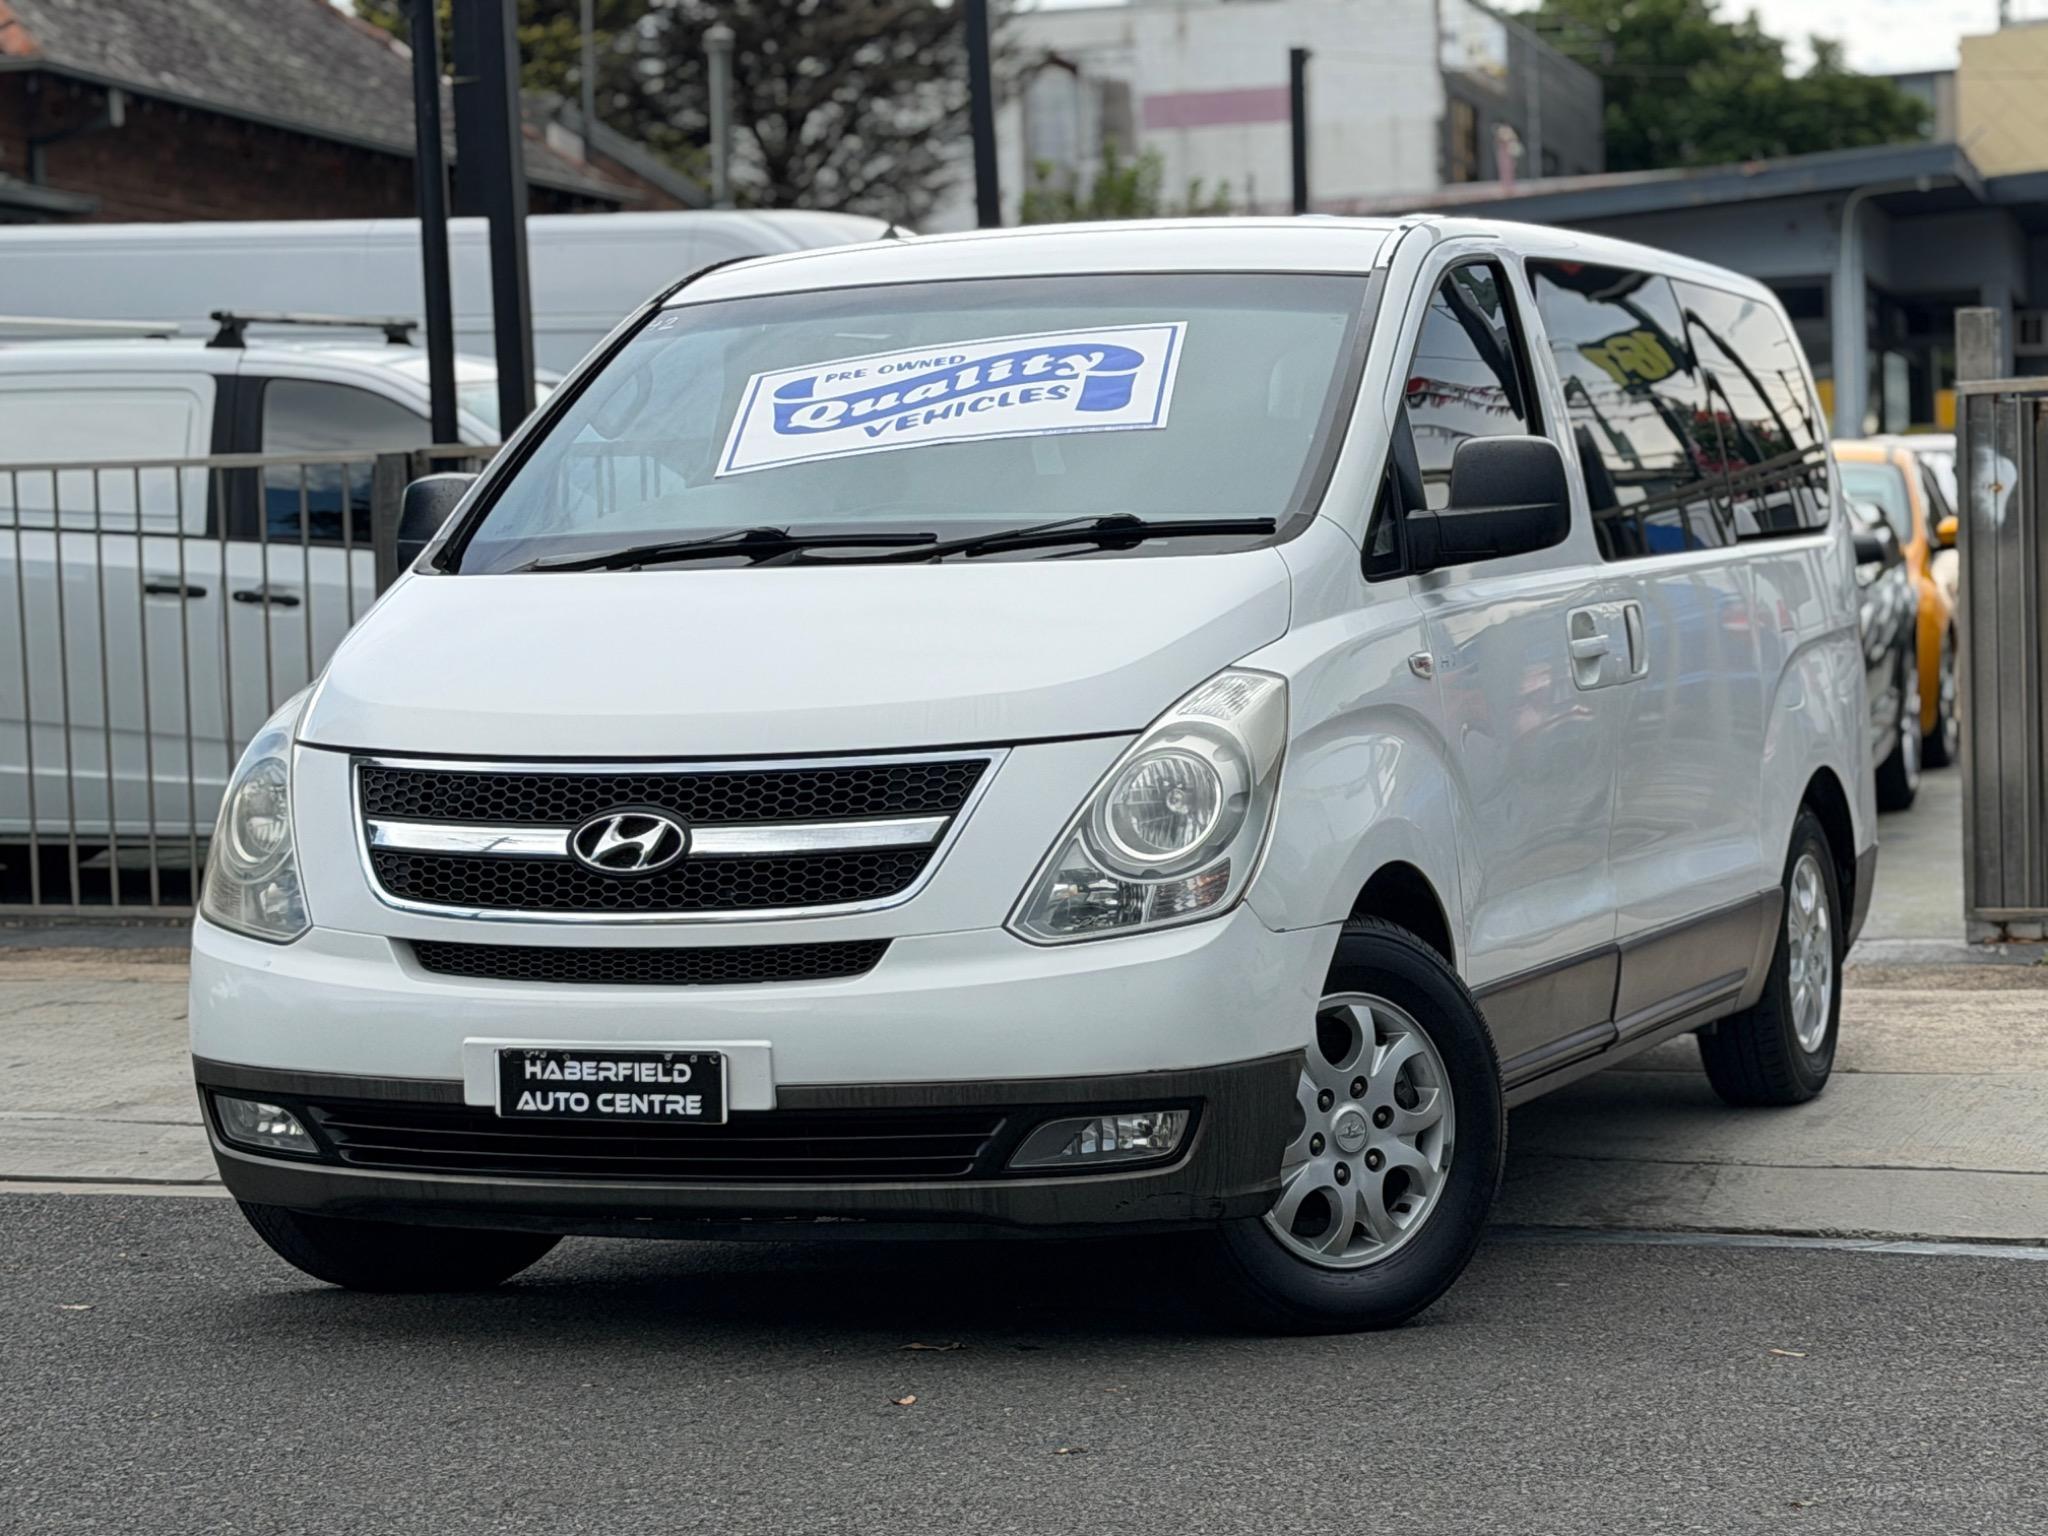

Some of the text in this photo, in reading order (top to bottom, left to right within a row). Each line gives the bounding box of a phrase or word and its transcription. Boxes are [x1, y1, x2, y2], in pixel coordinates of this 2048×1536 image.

[825, 354, 966, 383] PRE OWNED
[787, 351, 1105, 429] Quality
[864, 384, 1071, 438] VEHICLES
[524, 1059, 692, 1083] HABERFIELD
[516, 1090, 703, 1115] AUTO CENTRE
